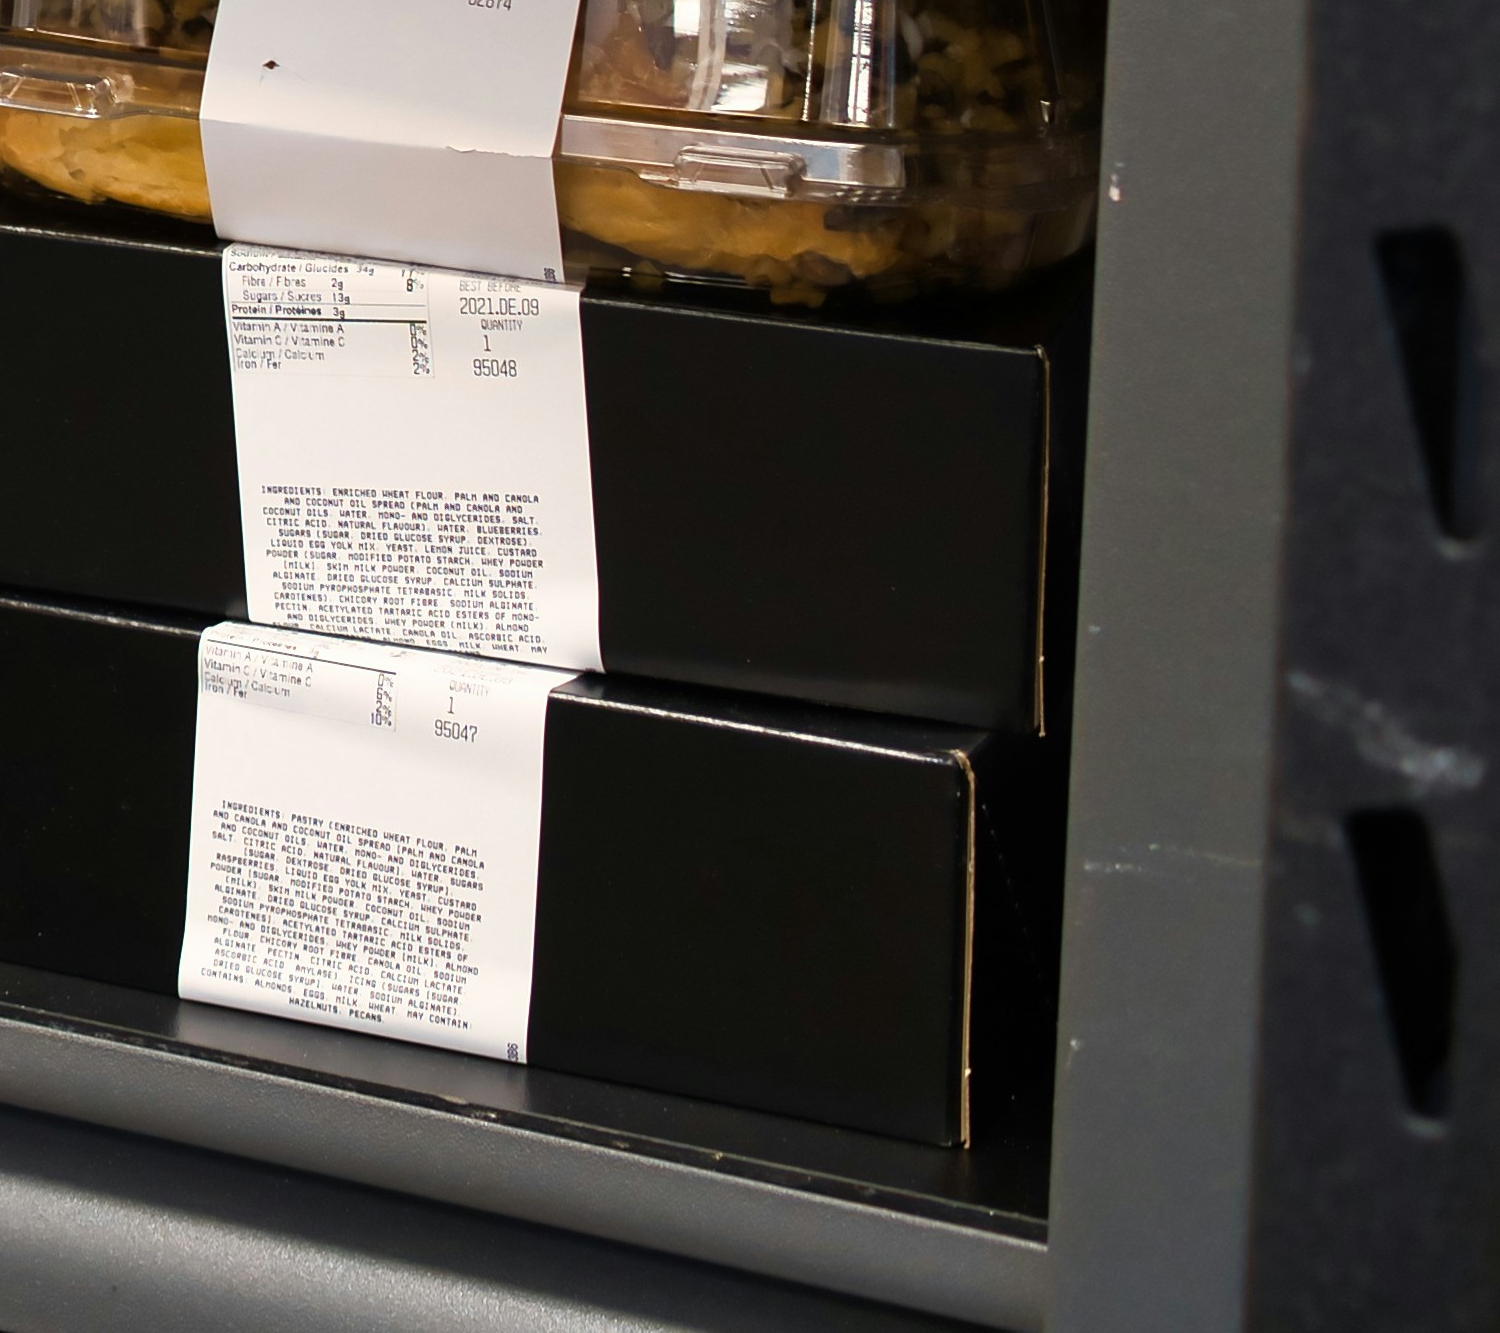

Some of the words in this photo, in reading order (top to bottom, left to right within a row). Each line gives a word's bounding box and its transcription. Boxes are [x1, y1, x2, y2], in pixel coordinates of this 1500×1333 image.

[229, 262, 296, 275] Carbohydrate
[231, 304, 267, 315] Protein
[460, 297, 540, 316] 2021.DE.09
[481, 319, 523, 331] QUANTITY
[483, 335, 492, 352] 1
[473, 358, 518, 378] 95048
[332, 488, 377, 498] ENRICHED
[382, 490, 409, 499] WHEAT
[454, 492, 477, 501] PALM
[482, 493, 500, 502] AND
[505, 494, 539, 503] CANOLA
[284, 497, 300, 506] AND
[306, 498, 344, 507] COCONUT
[349, 499, 366, 508] OIL
[372, 500, 405, 509] SPREAD
[444, 503, 461, 511] AND
[466, 503, 500, 513] CANOLA
[505, 504, 523, 513] AND
[447, 696, 454, 714] 1
[434, 719, 478, 743] 95047
[291, 813, 324, 827] PASTRY
[383, 831, 410, 844] WHEAT
[454, 845, 478, 857] PALM
